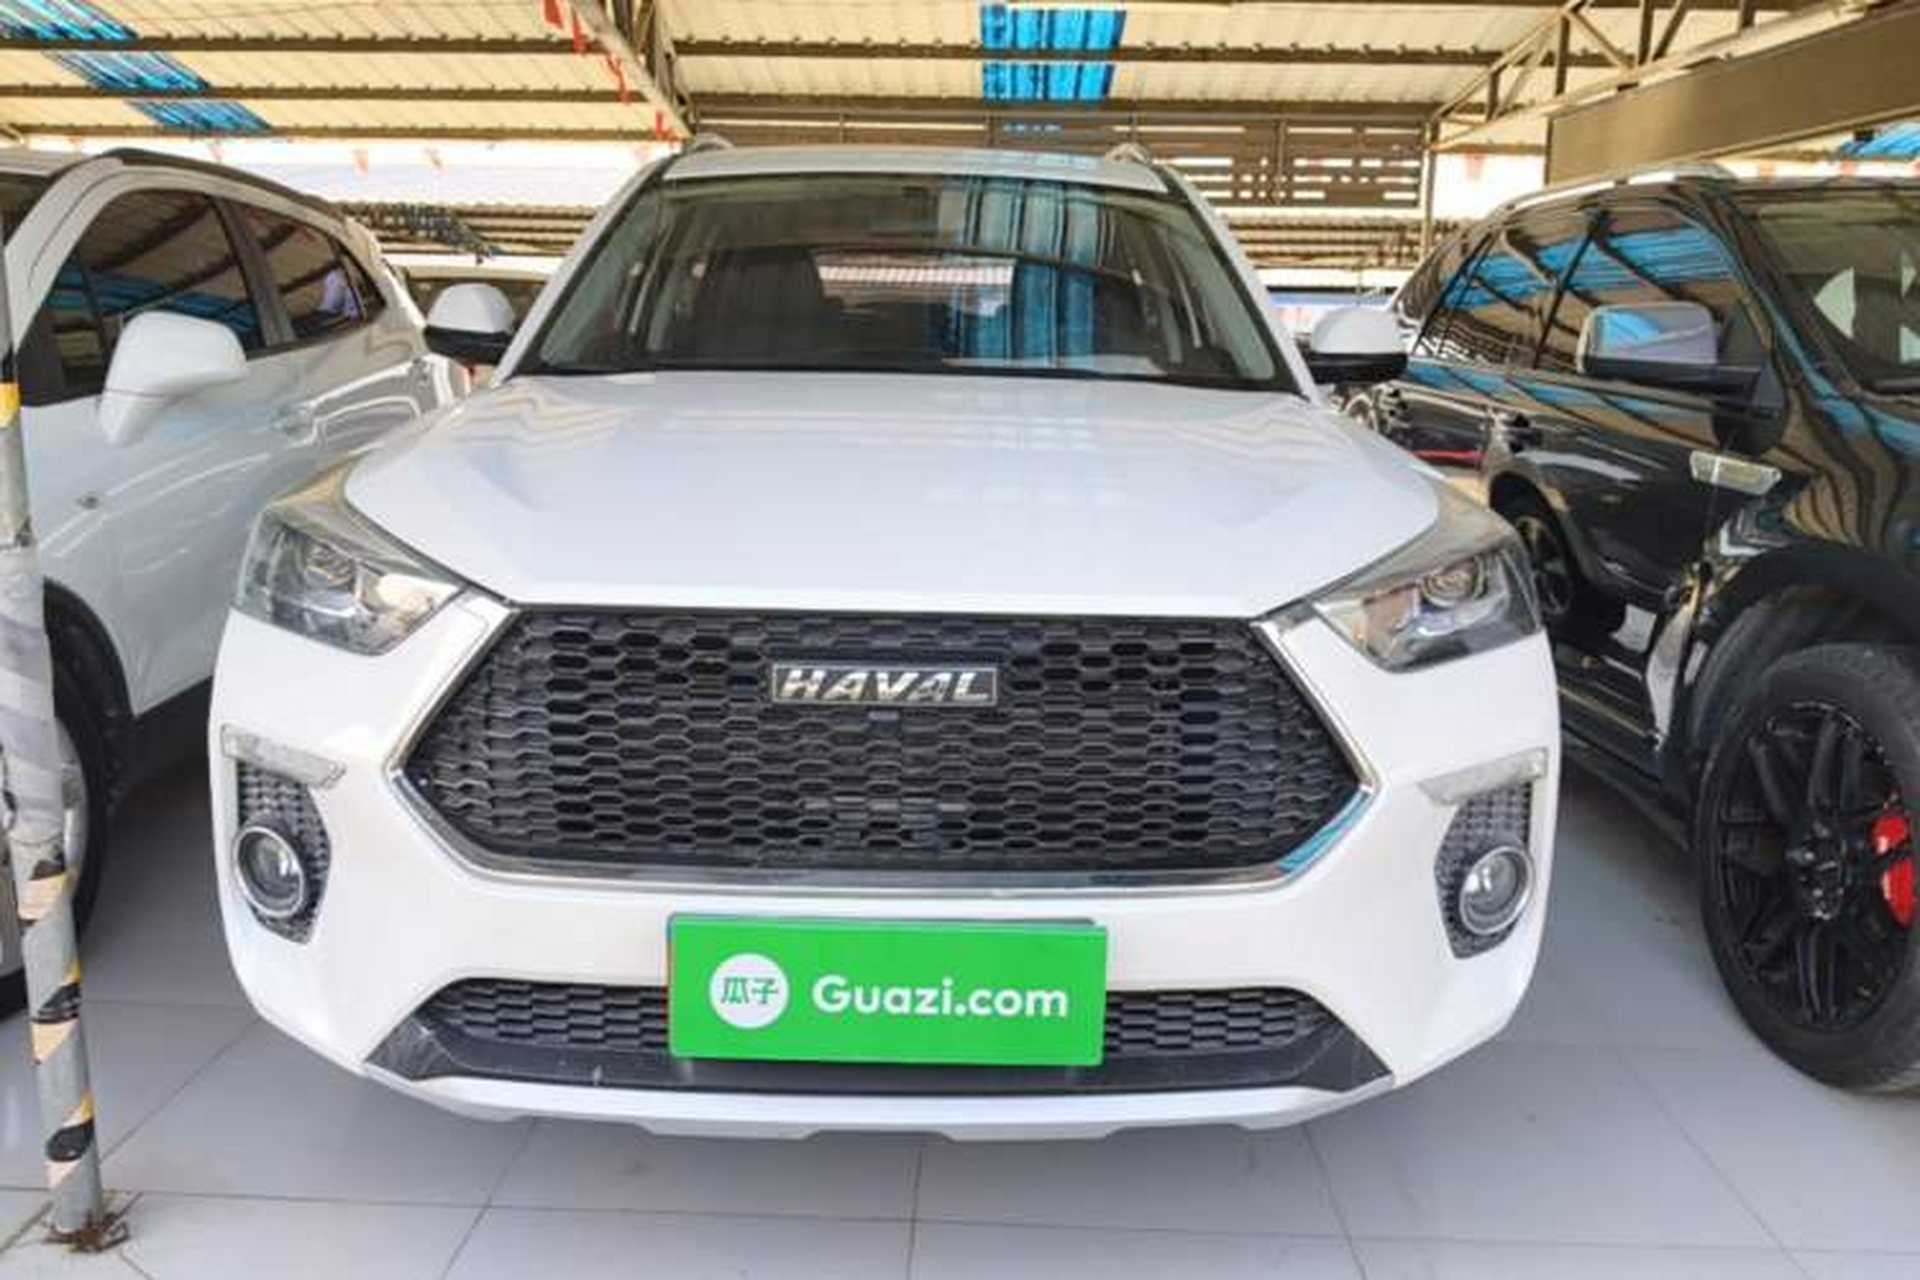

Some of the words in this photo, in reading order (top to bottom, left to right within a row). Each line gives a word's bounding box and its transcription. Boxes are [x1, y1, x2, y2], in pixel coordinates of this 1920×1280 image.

[780, 669, 989, 701] HAVAL
[720, 975, 780, 1006] 瓜子
[811, 974, 1069, 1018] Guazi.com
